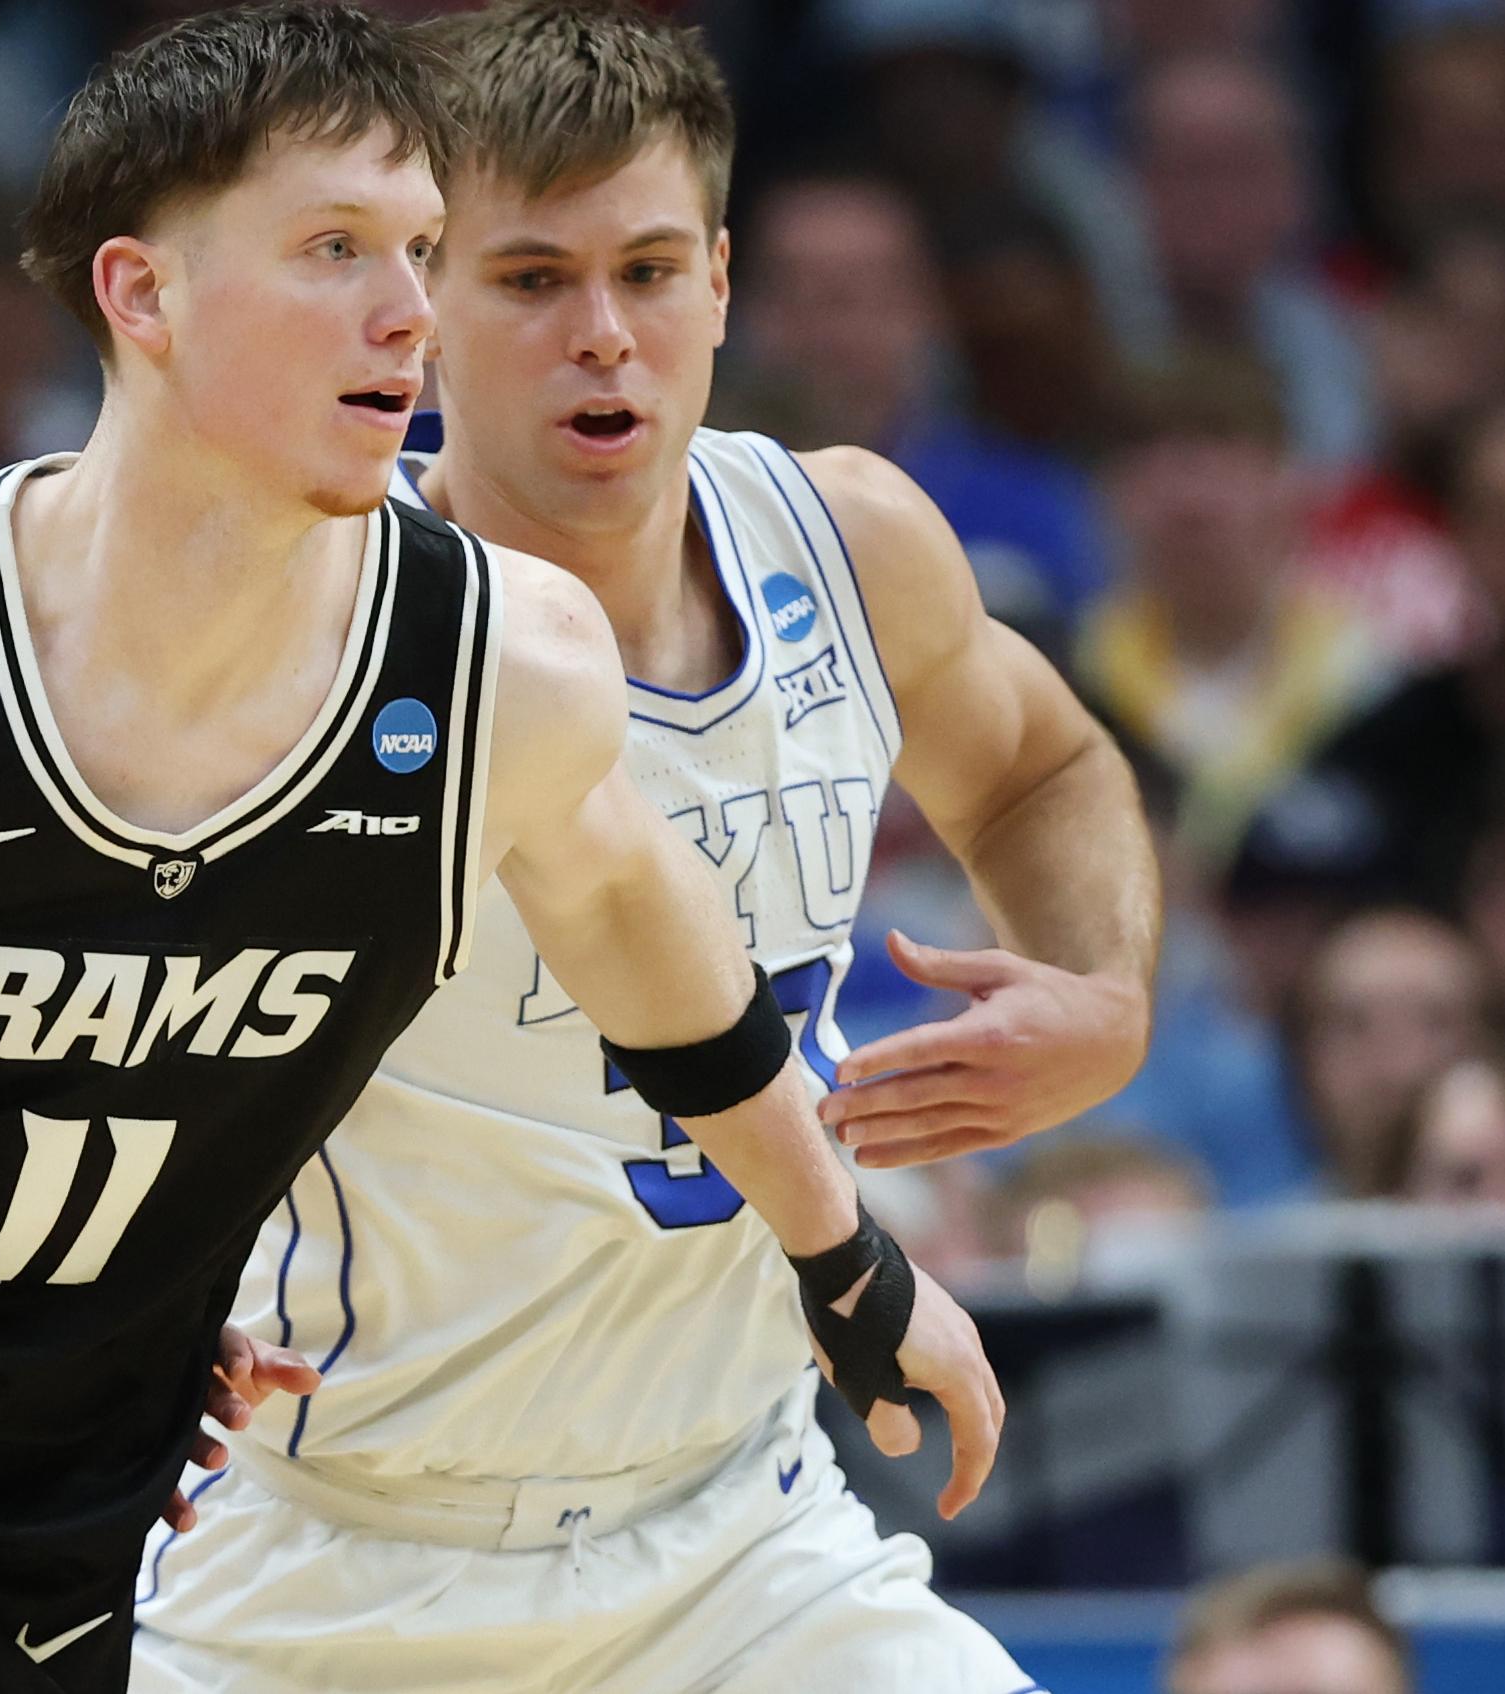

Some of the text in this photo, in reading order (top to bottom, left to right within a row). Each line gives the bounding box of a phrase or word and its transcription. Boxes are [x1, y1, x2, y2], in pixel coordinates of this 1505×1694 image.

[771, 594, 815, 631] NCAA
[379, 734, 434, 755] NCAA
[306, 809, 421, 836] A10
